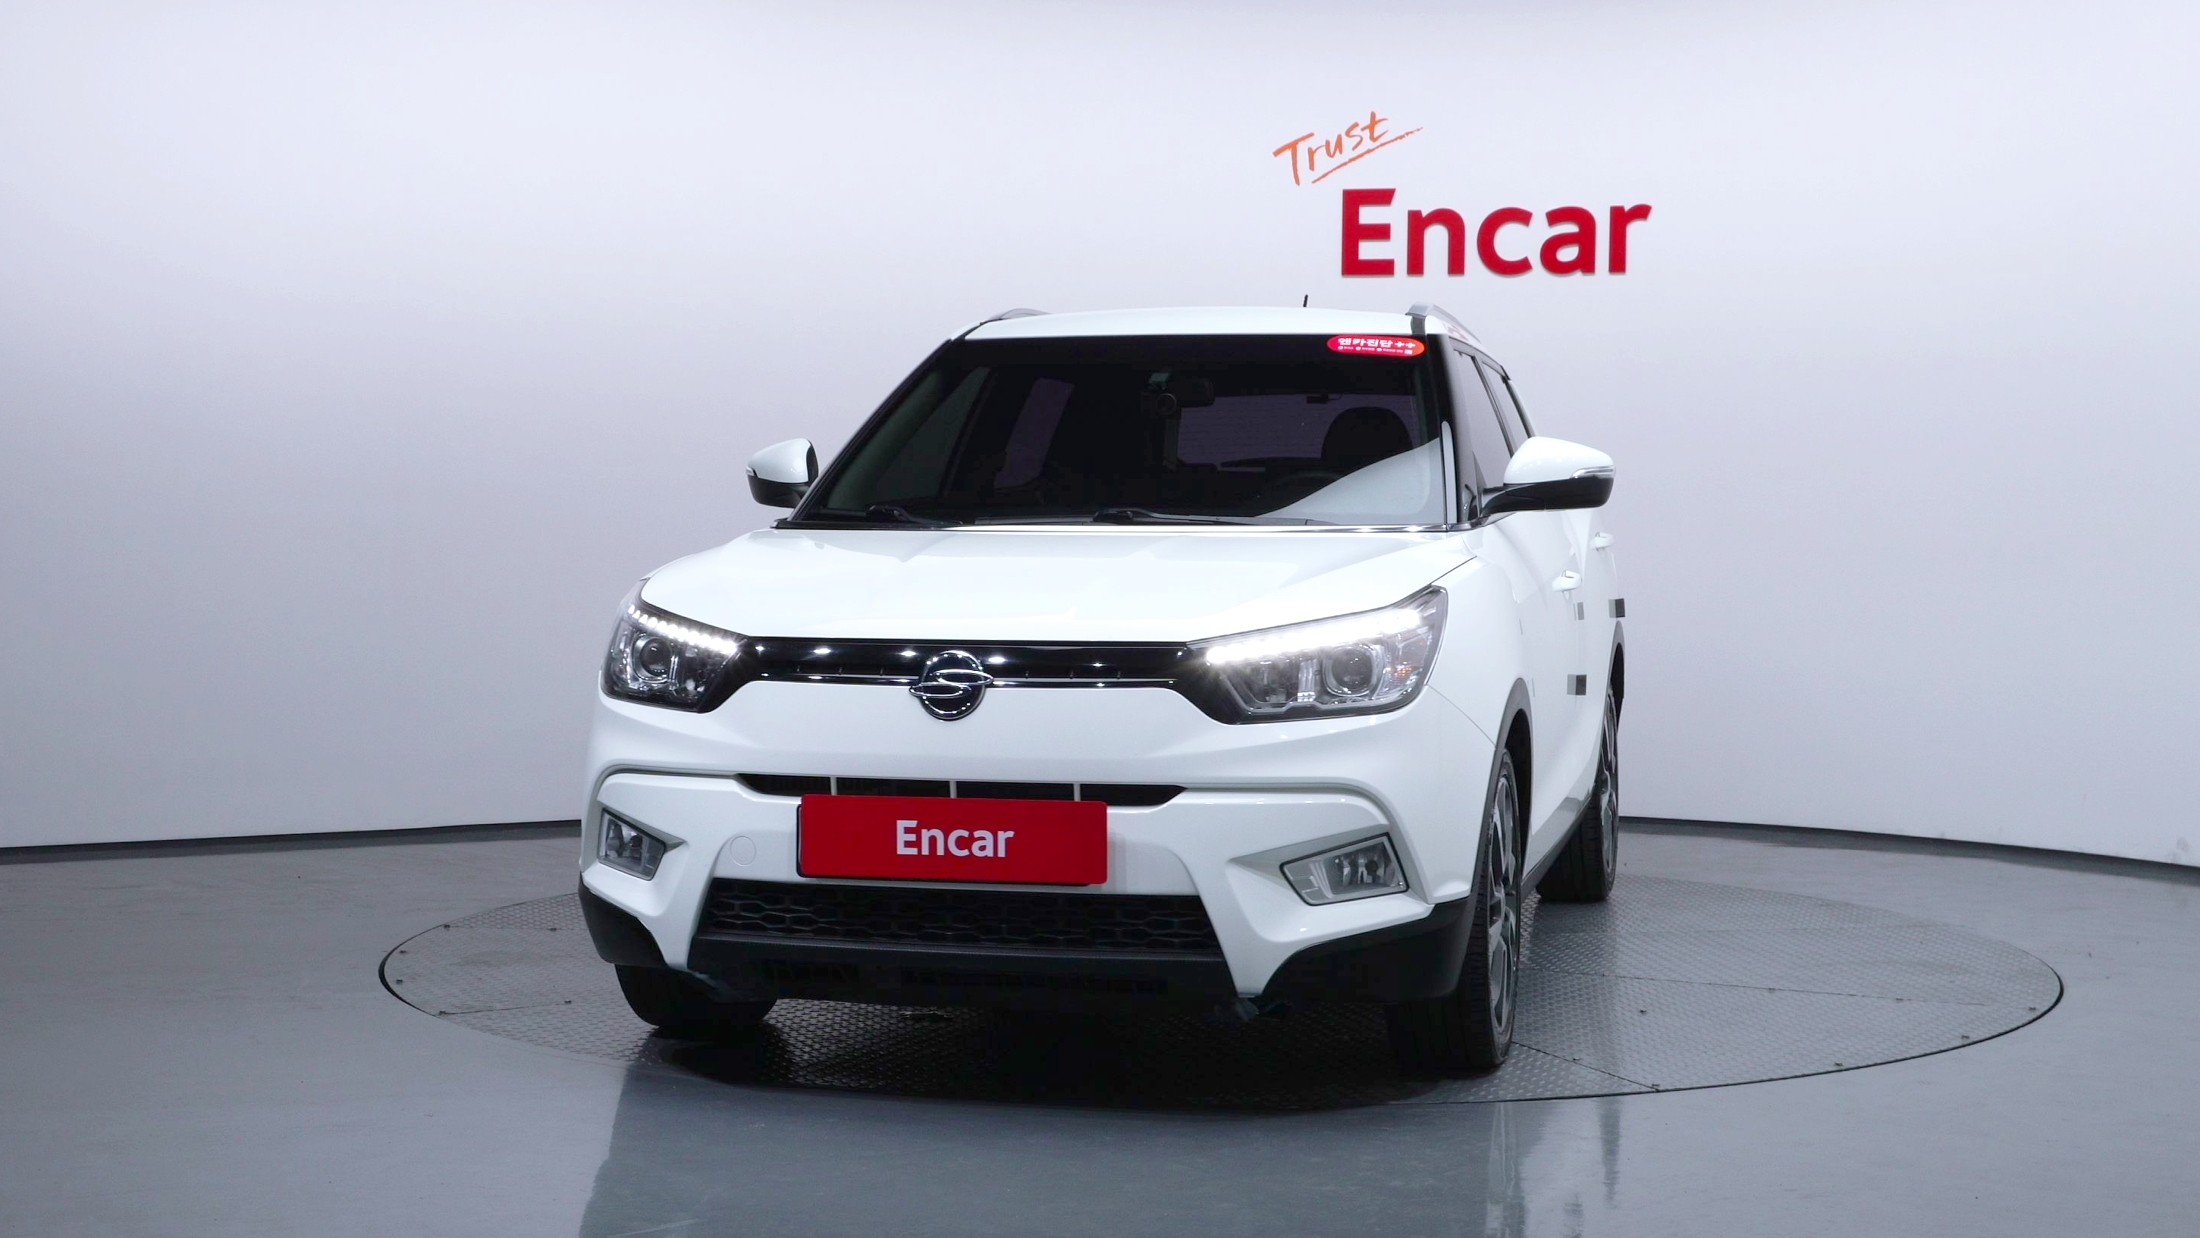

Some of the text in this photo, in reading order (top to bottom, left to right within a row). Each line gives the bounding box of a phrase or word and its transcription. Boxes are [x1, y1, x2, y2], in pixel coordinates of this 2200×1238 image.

[1273, 111, 1389, 186] Trust
[1341, 188, 1652, 276] Encar
[896, 819, 1015, 858] Encar
